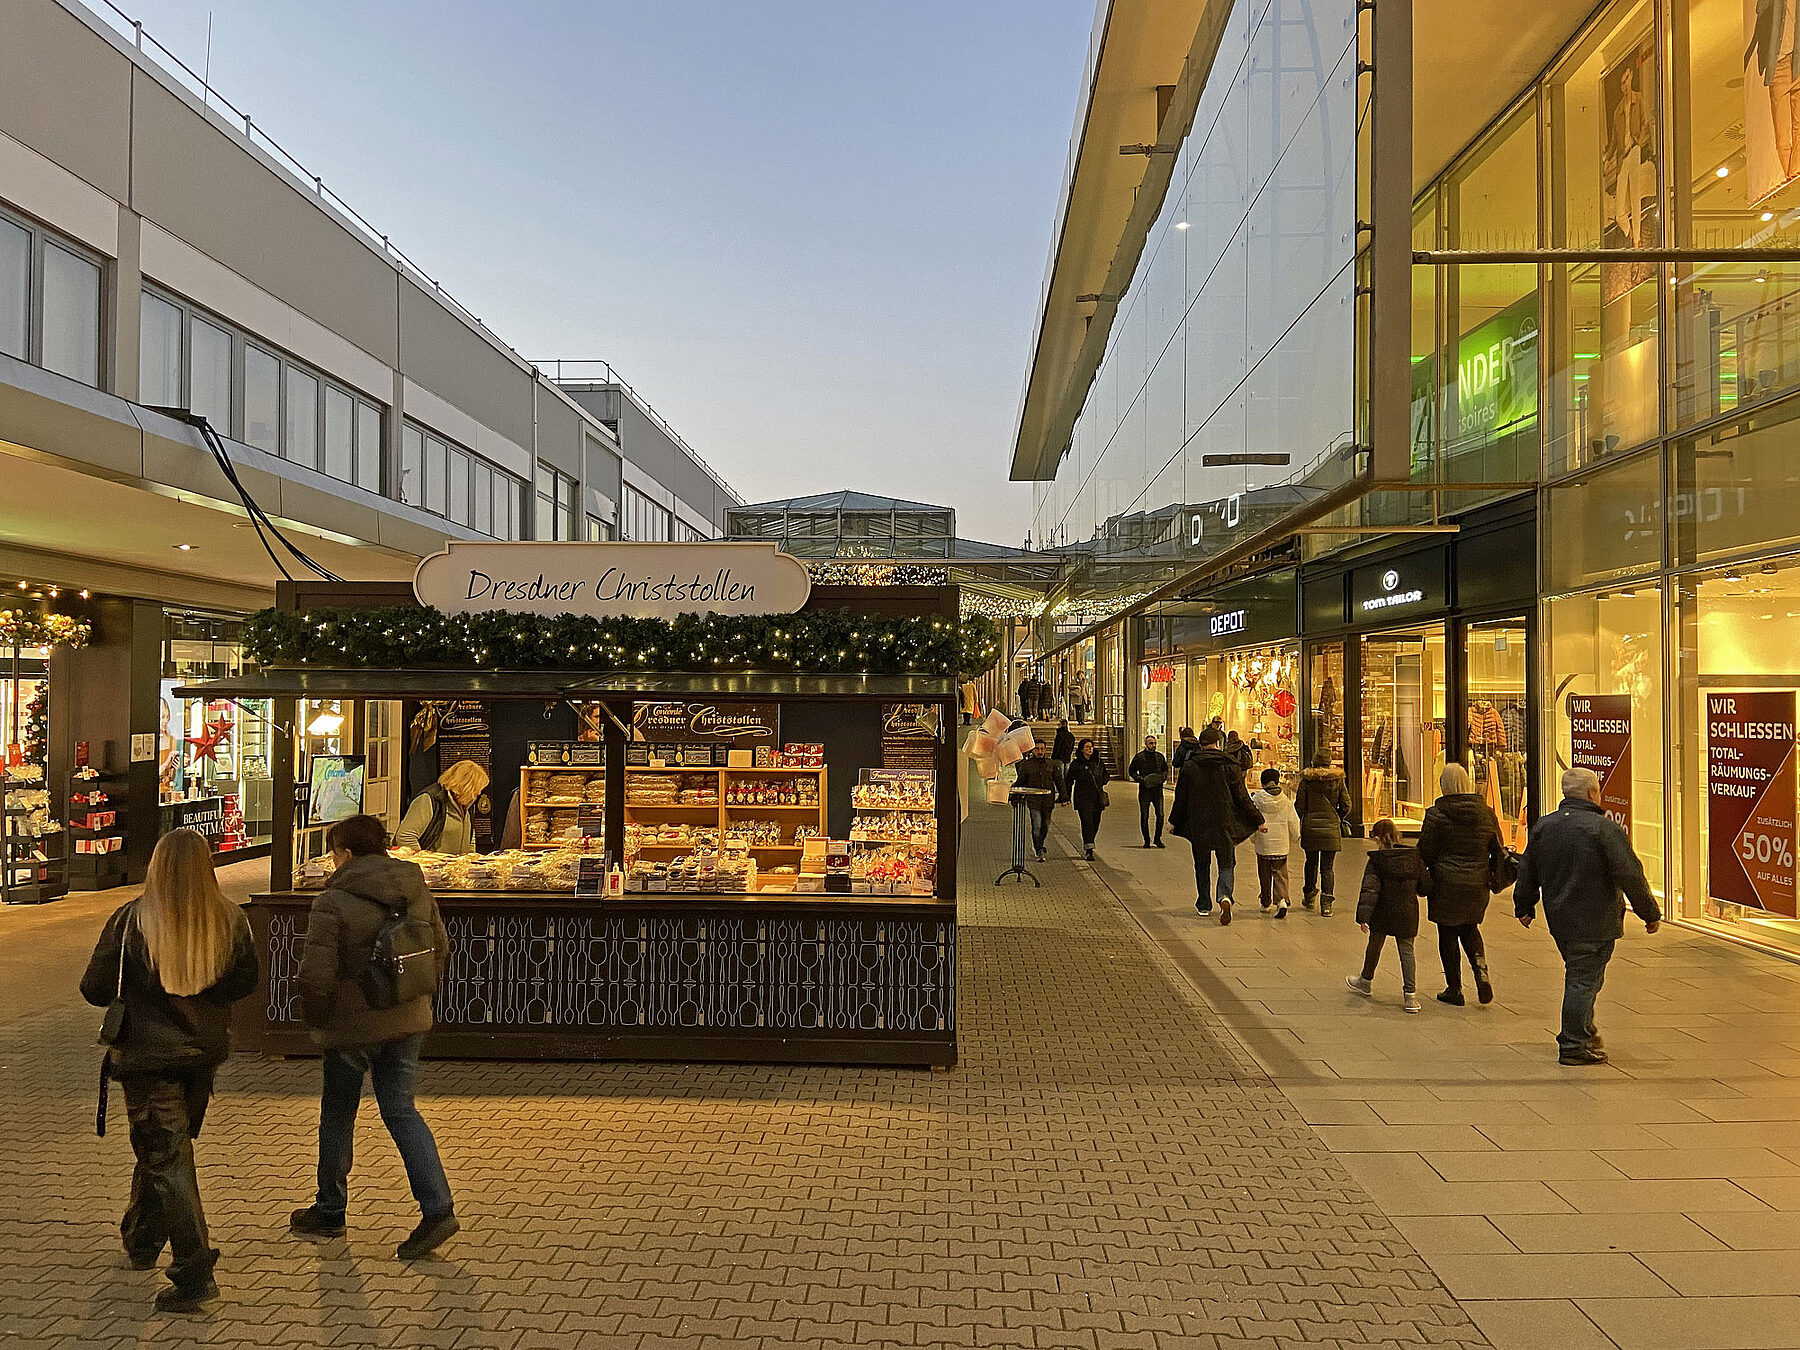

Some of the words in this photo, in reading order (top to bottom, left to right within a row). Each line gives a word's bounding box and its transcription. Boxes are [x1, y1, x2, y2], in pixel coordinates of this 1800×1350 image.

[464, 568, 586, 601] Dresdner
[595, 567, 755, 602] Christstollen
[1387, 590, 1422, 606] TAILOR
[1210, 609, 1245, 634] DEPOT
[1572, 699, 1592, 713] WIR
[1710, 698, 1737, 715] WIR
[1573, 718, 1630, 734] SCHLIESSEN
[1710, 721, 1794, 740] SCHLIESSEN
[1573, 739, 1597, 750] TOTAL-
[1573, 752, 1615, 767] RÄUMUNGS-
[1710, 746, 1744, 760] TOTAL-
[1711, 762, 1772, 781] RÄUMUNGS-
[1710, 782, 1757, 799] VERKAUF
[1605, 809, 1629, 835] 0%
[1756, 816, 1793, 829] ZUSÄTZLICH
[1742, 831, 1793, 868] 50%
[1757, 871, 1771, 881] AUF
[1771, 874, 1793, 886] ALLES
